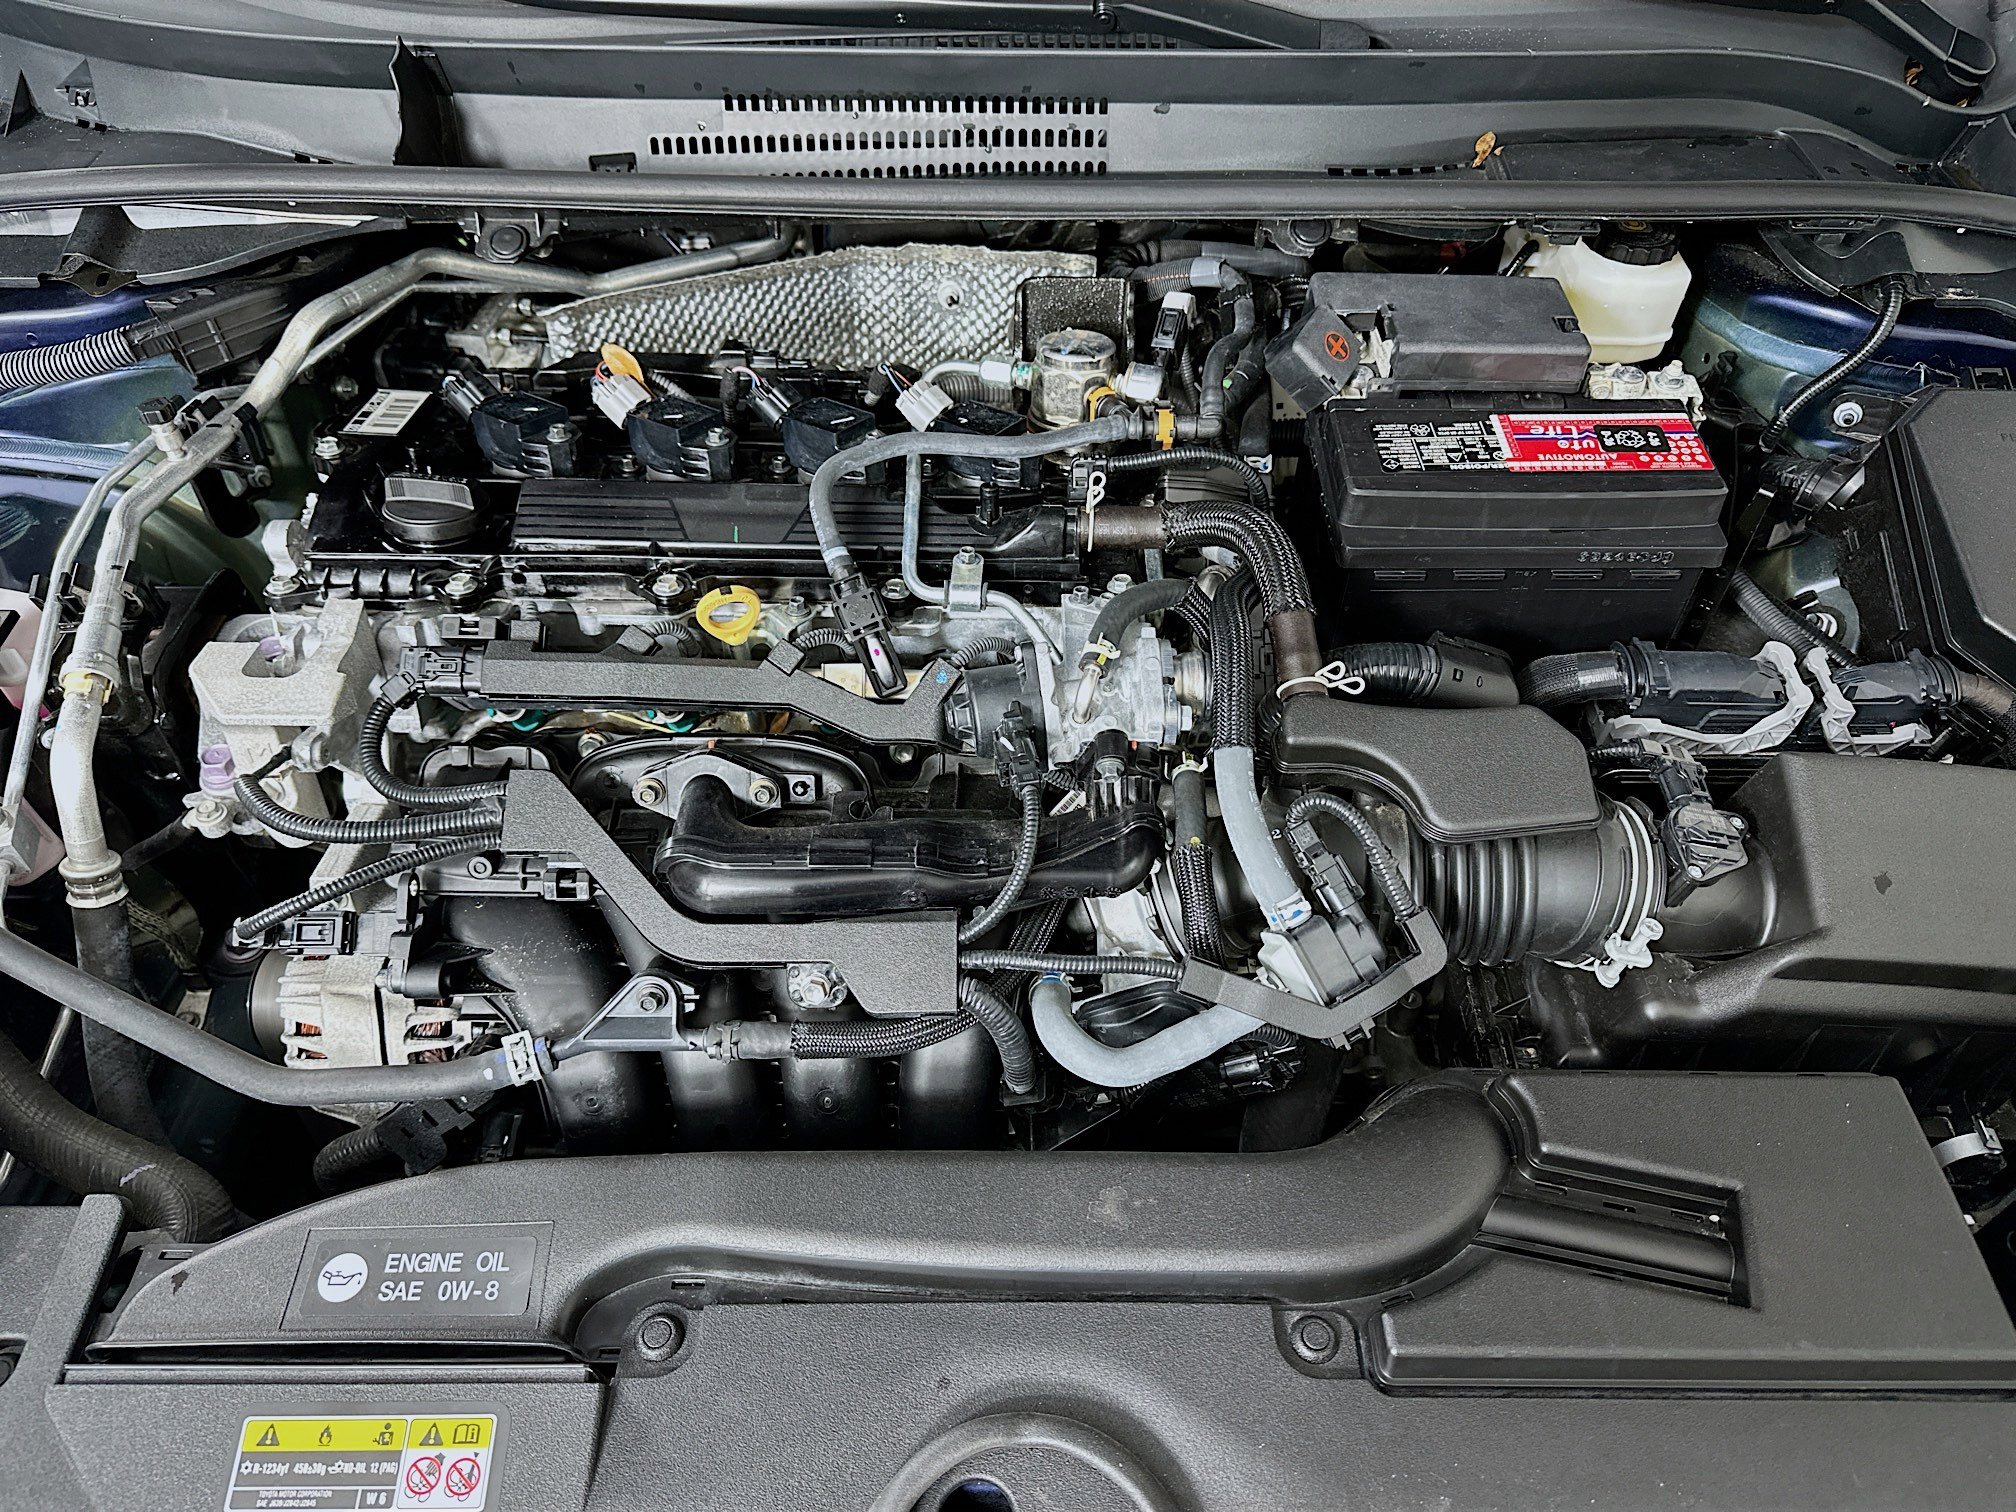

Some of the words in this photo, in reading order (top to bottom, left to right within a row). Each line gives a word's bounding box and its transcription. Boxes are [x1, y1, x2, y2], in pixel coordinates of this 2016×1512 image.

[1537, 453, 1618, 462] AUTOMOTIVE
[384, 1252, 463, 1273] ENGINE
[476, 1252, 510, 1272] OIL
[378, 1280, 424, 1301] SAE
[437, 1280, 499, 1301] 0W-8
[252, 1462, 290, 1476] R-1234yf
[370, 1461, 379, 1474] 12
[259, 1490, 278, 1498] TOYOTA
[279, 1489, 297, 1498] MOTOR
[297, 1488, 332, 1497] CORPORATION
[366, 1491, 378, 1505] W
[378, 1491, 388, 1505] 6
